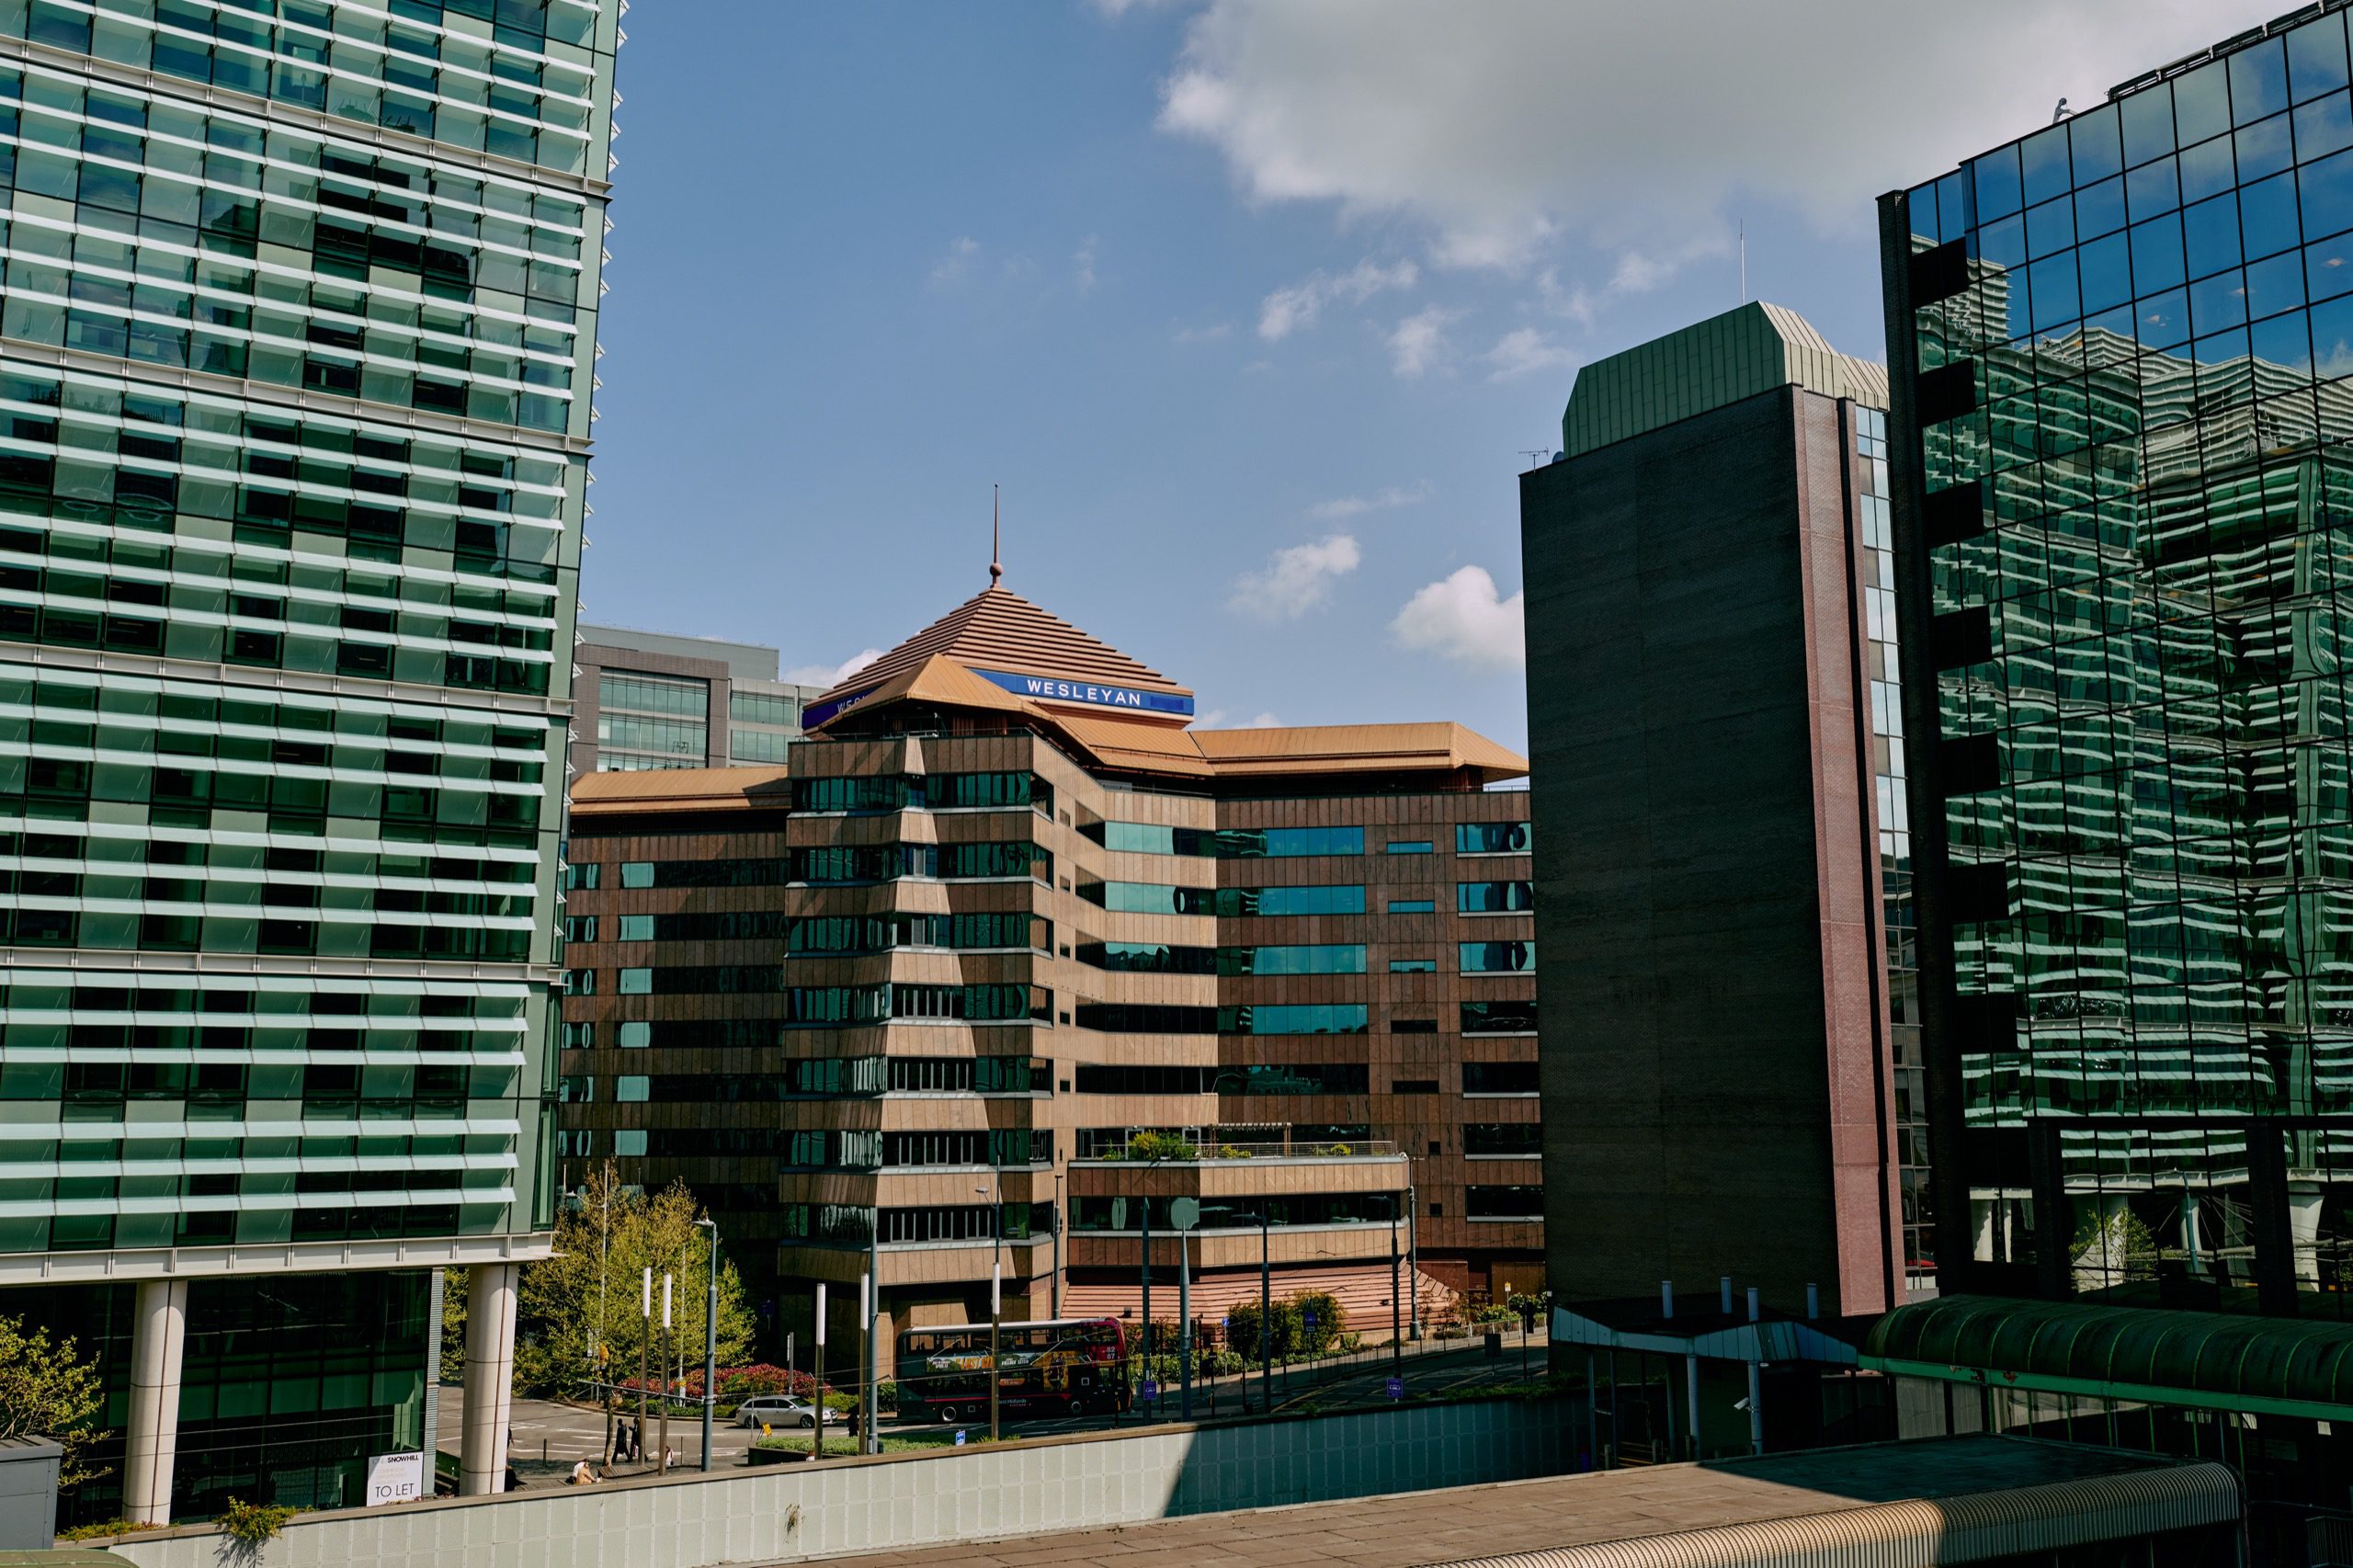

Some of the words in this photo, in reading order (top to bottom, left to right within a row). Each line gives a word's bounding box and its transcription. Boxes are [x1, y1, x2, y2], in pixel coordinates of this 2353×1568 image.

[1027, 678, 1141, 706] WESLEYAN
[387, 1455, 419, 1463] SNOWHILL
[375, 1485, 392, 1497] TO
[395, 1483, 415, 1495] LET
